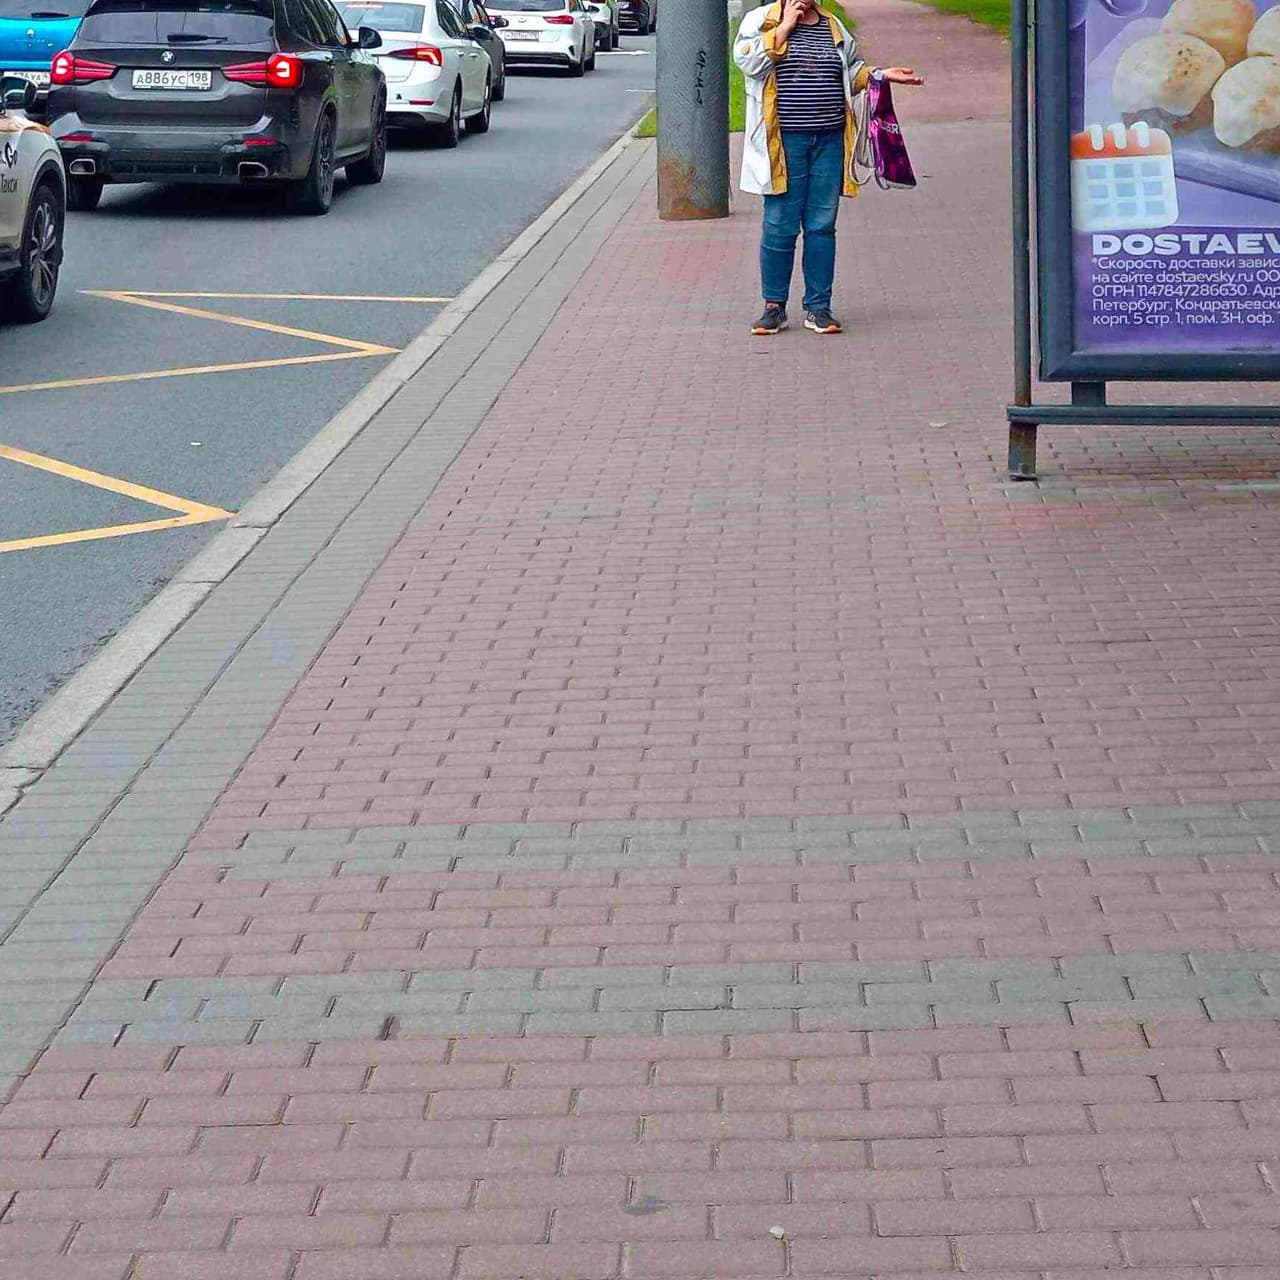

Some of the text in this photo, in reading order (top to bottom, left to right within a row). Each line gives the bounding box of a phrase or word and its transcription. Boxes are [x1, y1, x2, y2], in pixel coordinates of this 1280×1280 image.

[1170, 258, 1235, 270] доставки
[1092, 273, 1110, 283] на
[1112, 271, 1154, 283] сайте
[1156, 270, 1254, 286] dostaevsky.ru
[1092, 284, 1134, 297] ОГРН
[1133, 312, 1144, 325] 5
